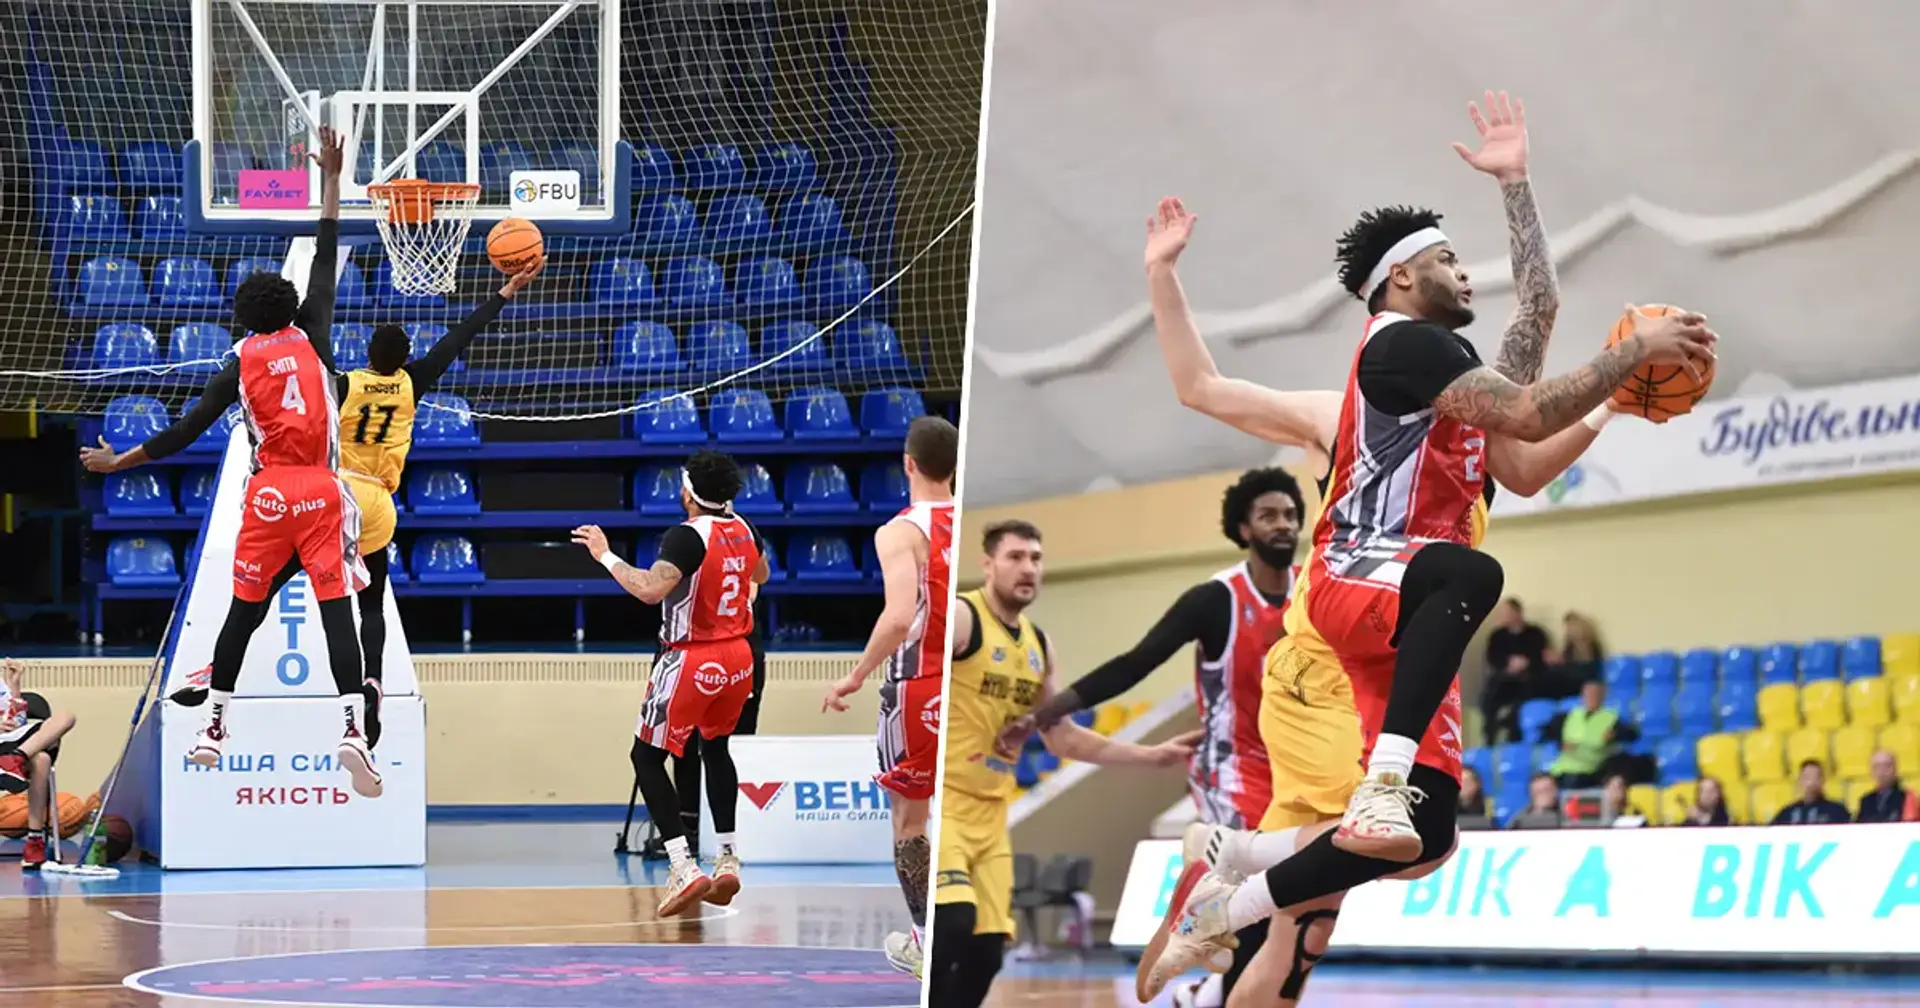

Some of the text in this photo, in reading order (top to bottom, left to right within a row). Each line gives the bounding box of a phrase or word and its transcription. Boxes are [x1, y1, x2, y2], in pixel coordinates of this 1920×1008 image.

[244, 189, 303, 199] FAVBET
[539, 183, 577, 200] FBU
[281, 374, 307, 415] 4
[354, 403, 399, 444] 17
[252, 495, 327, 517] auto plus
[717, 574, 741, 616] 2
[276, 569, 310, 686] ЕТО
[694, 670, 728, 685] auto
[236, 787, 350, 805] ЯКІСТЬ
[794, 781, 891, 811] ВЕН
[795, 811, 889, 822] НАША СИЛА
